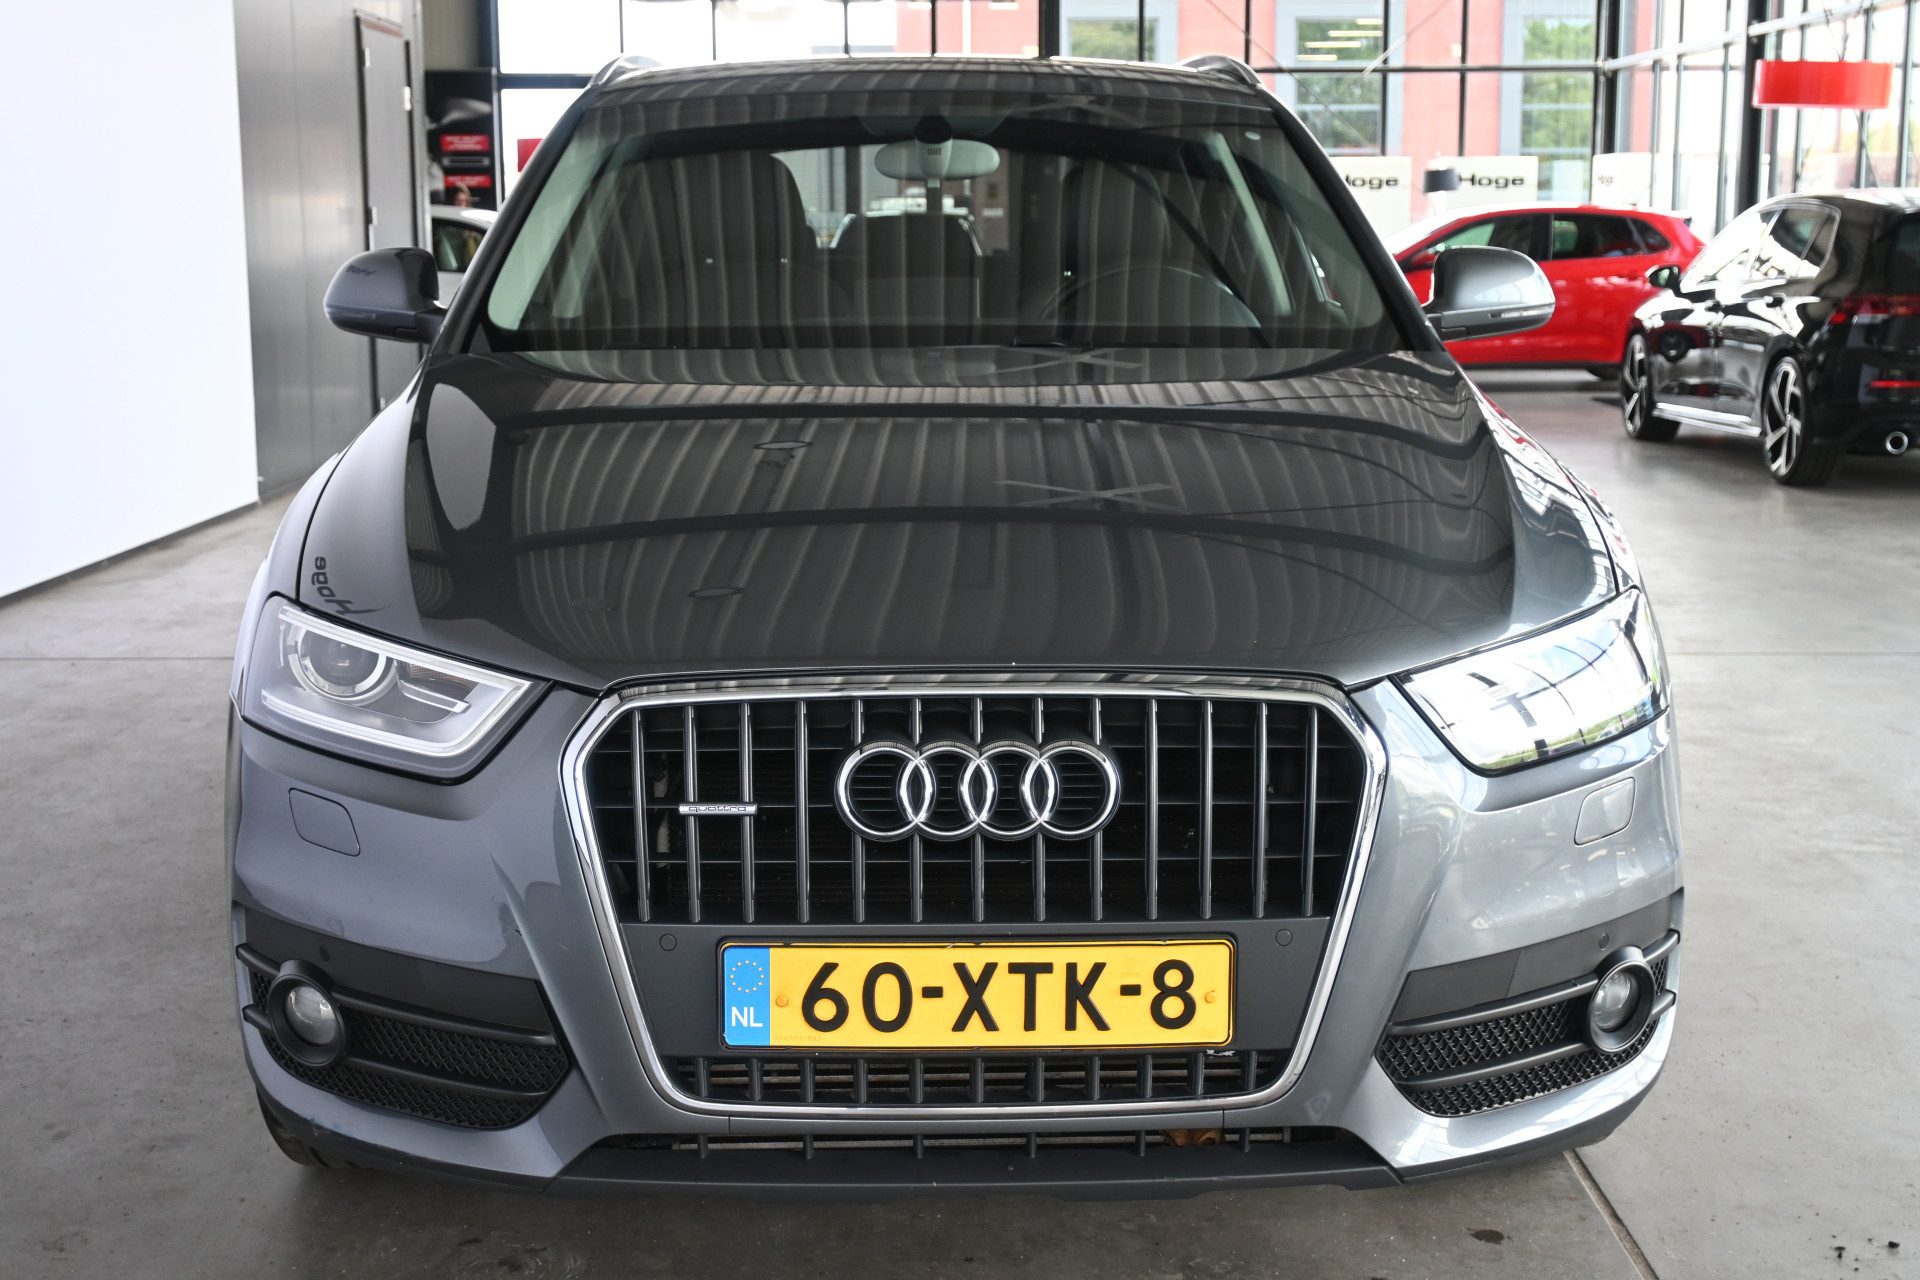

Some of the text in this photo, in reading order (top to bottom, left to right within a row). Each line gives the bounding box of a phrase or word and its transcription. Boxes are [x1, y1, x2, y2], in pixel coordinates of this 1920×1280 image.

[688, 805, 747, 813] quattro
[800, 959, 1197, 1033] 60-XTK-8
[731, 1006, 763, 1028] NL
